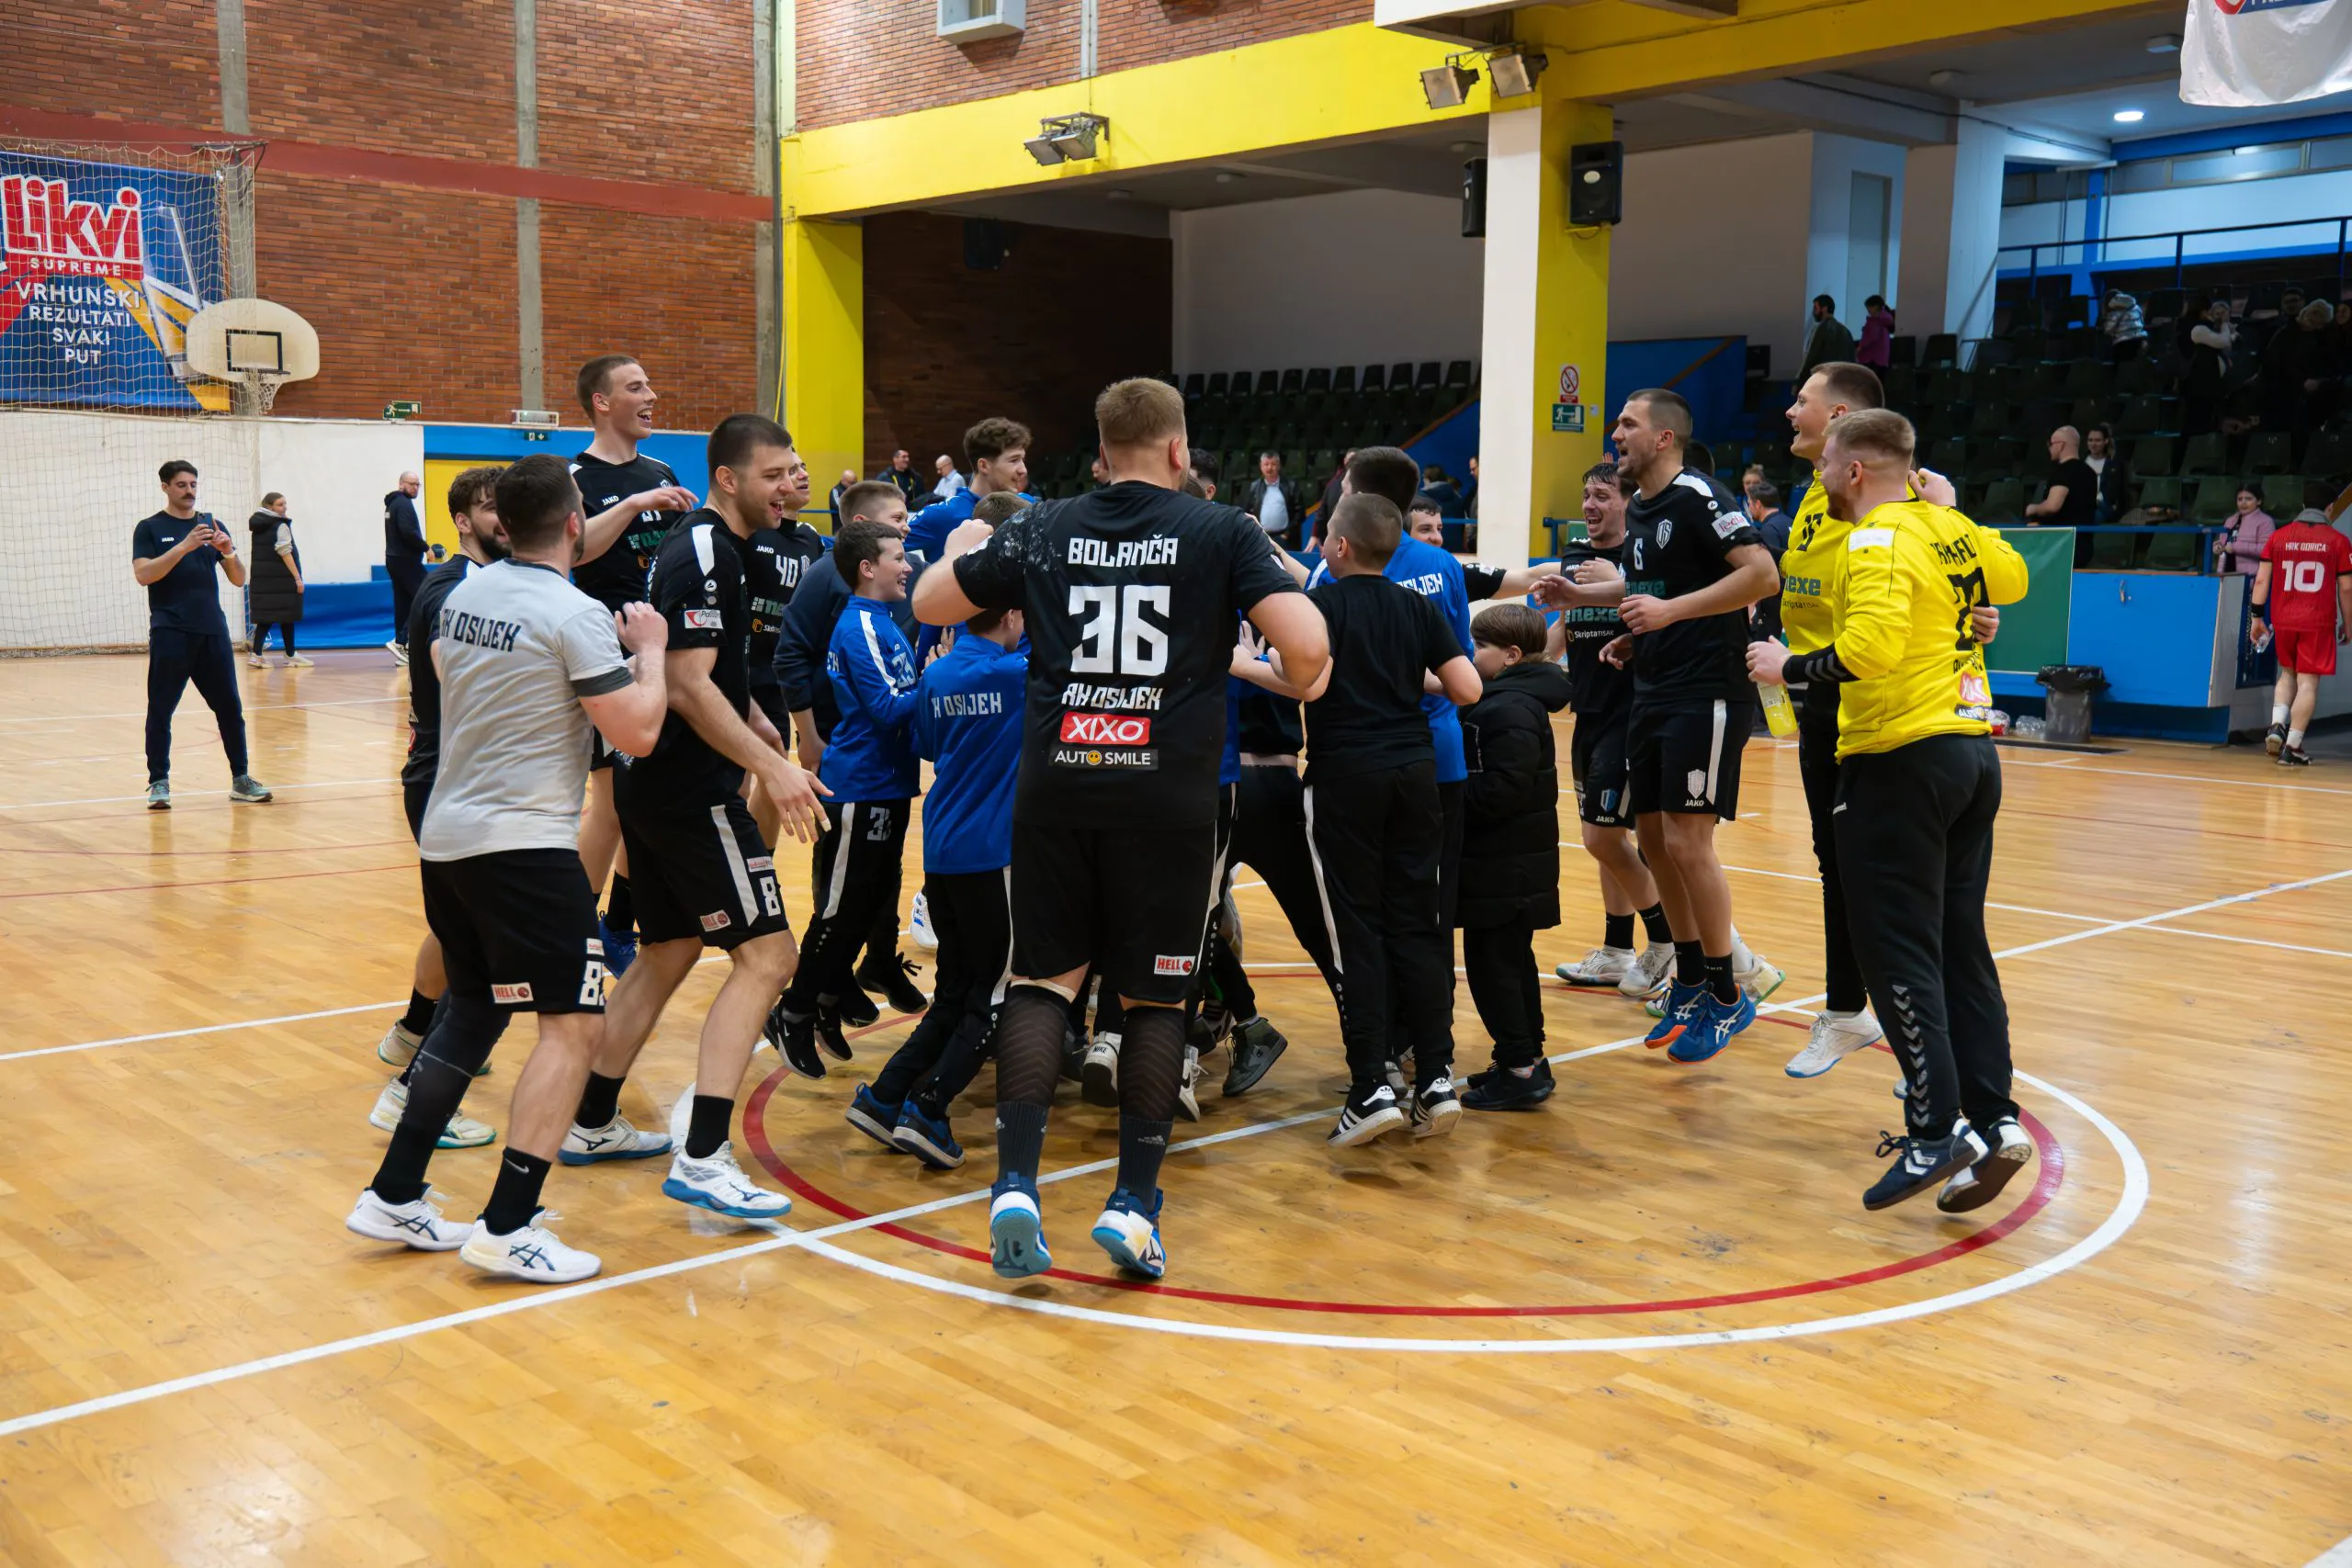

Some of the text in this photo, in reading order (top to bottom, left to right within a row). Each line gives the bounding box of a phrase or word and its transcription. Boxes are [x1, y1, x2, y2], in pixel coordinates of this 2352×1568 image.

[30, 257, 121, 276] SUPREME
[16, 281, 140, 309] VRHUNSKI
[29, 308, 130, 327] REZULTATI
[52, 328, 110, 345] SVAKI
[65, 348, 101, 365] PUT
[602, 496, 619, 506] JAKO
[756, 546, 774, 554] JAKO
[1068, 534, 1178, 568] BOLANČA
[1634, 538, 1643, 570] 6
[1396, 573, 1443, 595] IJEK
[2281, 560, 2325, 592] 10
[454, 612, 521, 652] OSIJEK
[1069, 585, 1170, 676] 36
[944, 693, 1001, 716] OSIJEK
[1091, 686, 1163, 710] OSIJEK
[1068, 716, 1144, 741] XIXO
[1104, 752, 1150, 765] SMILE
[1596, 815, 1614, 823] JAKO
[759, 876, 781, 917] 8
[1158, 958, 1181, 970] HELL
